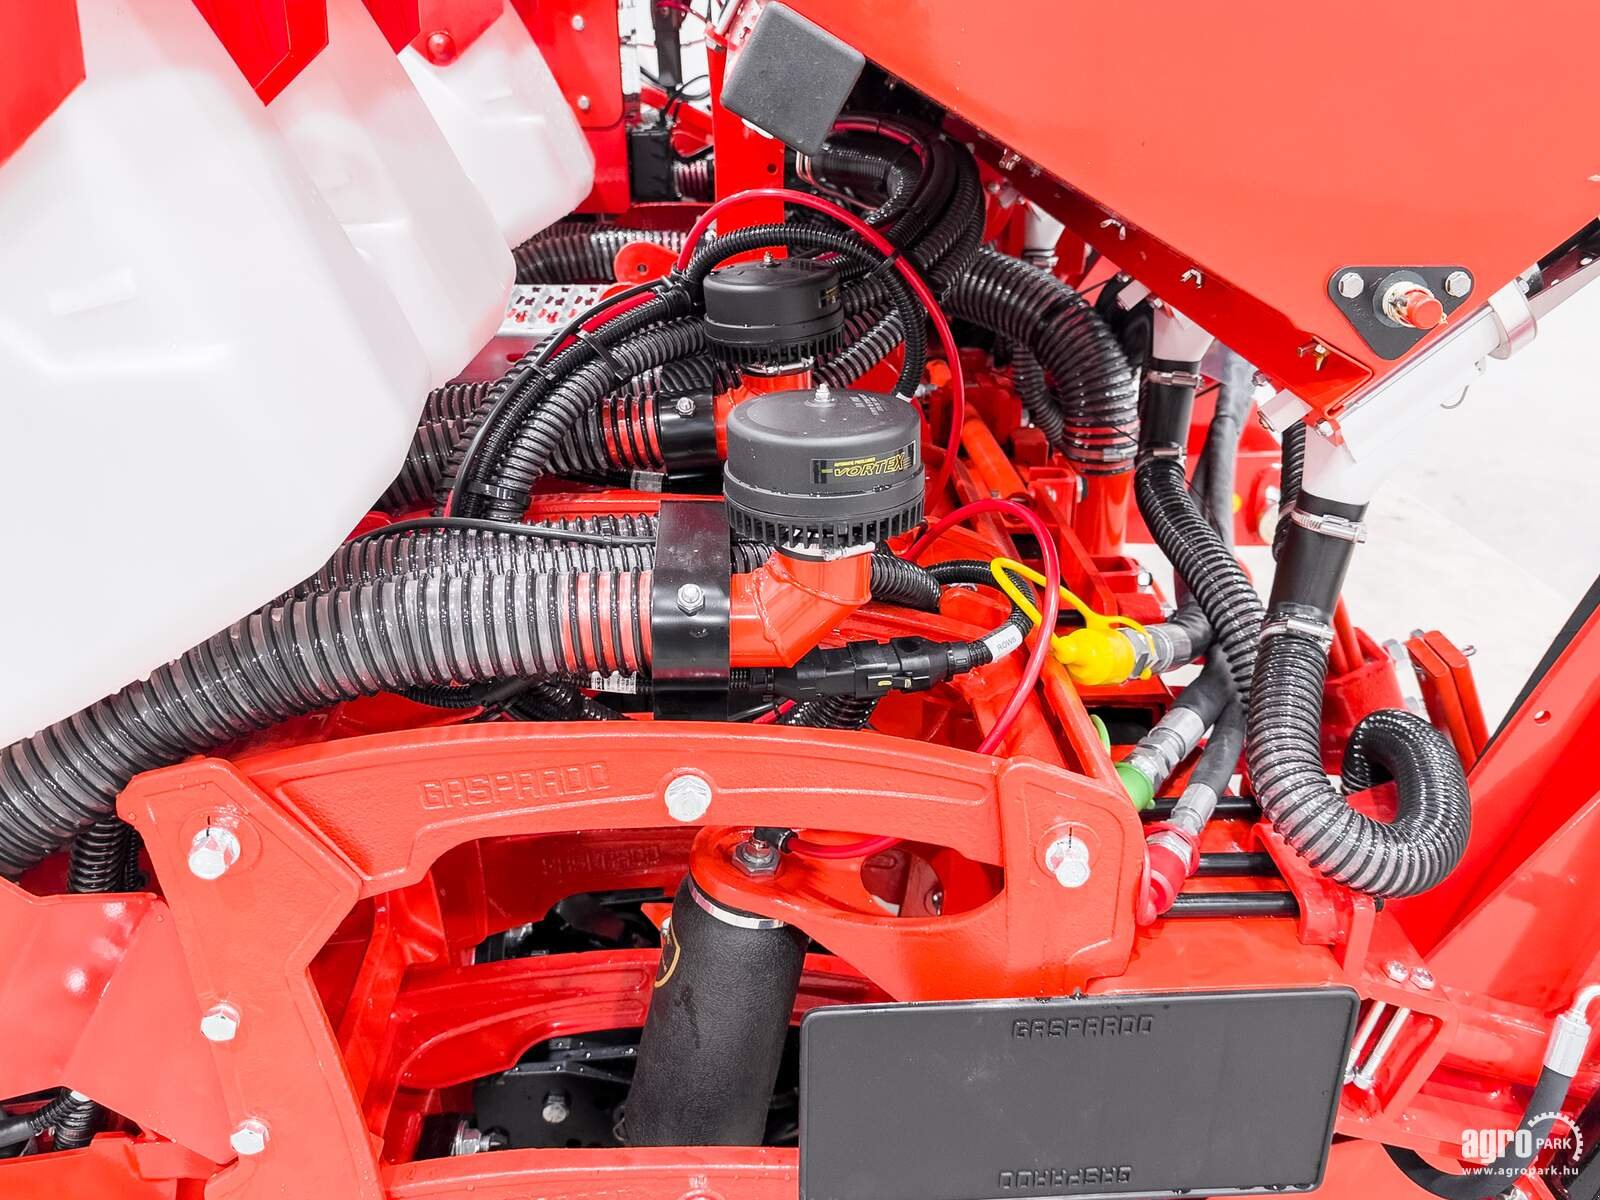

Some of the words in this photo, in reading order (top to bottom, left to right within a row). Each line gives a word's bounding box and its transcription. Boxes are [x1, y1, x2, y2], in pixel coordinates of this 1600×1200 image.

[834, 453, 905, 477] VORTEX
[418, 761, 610, 811] GASPARDO
[1012, 1014, 1154, 1039] GASPARDO
[998, 1166, 1132, 1189] GASPARDO
